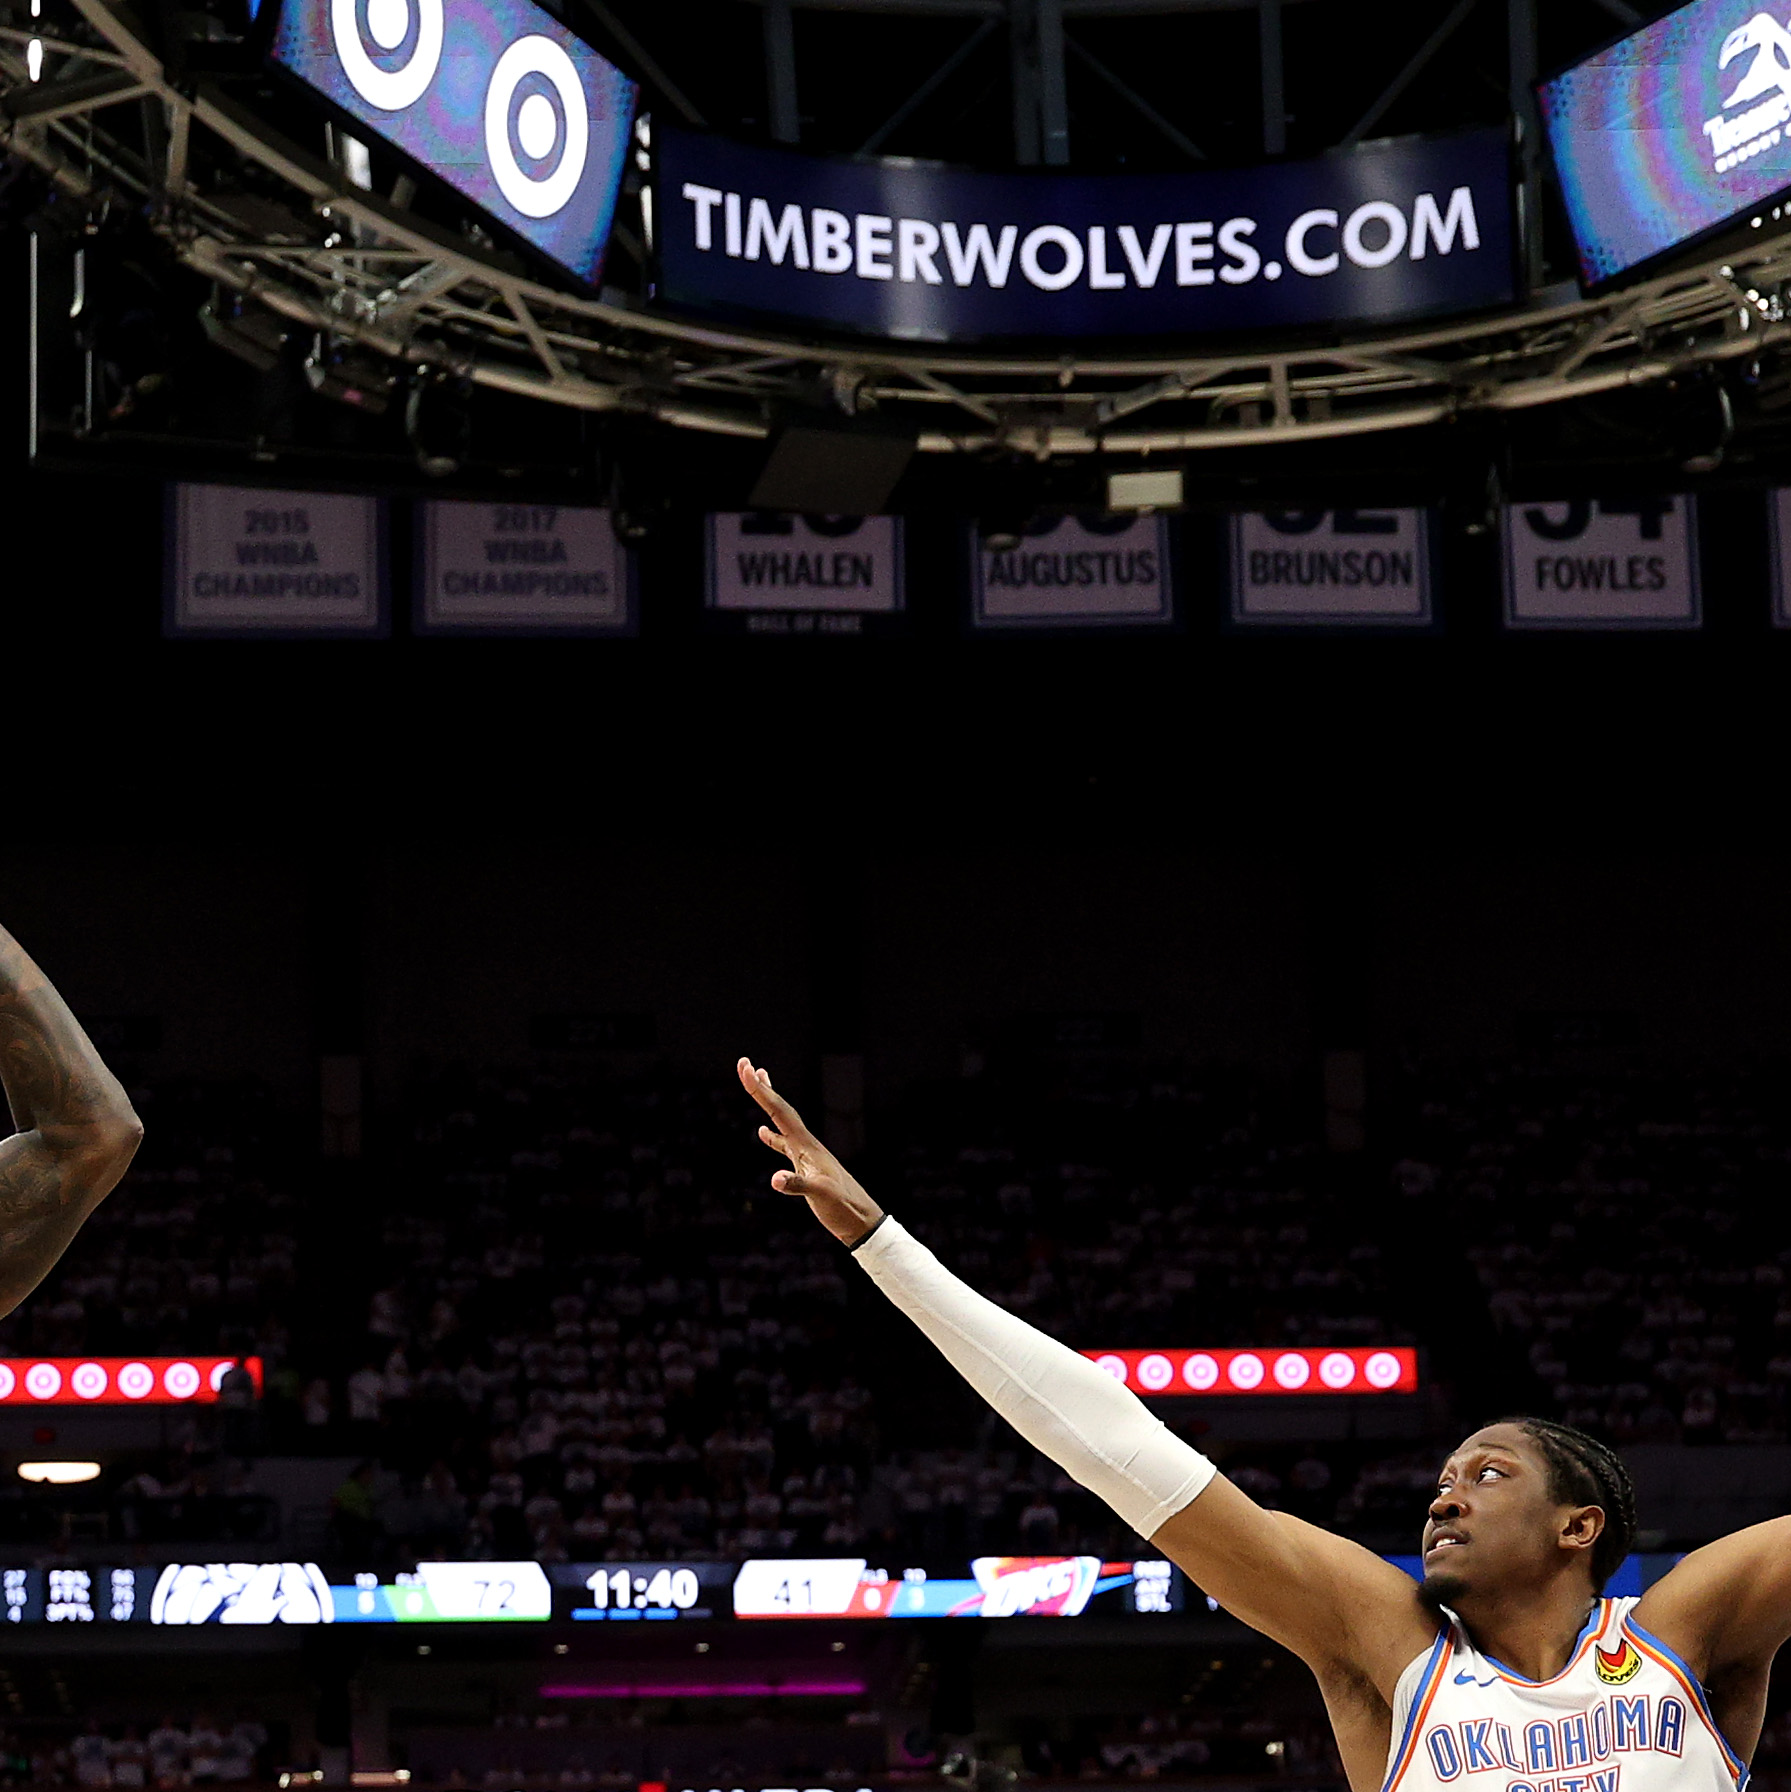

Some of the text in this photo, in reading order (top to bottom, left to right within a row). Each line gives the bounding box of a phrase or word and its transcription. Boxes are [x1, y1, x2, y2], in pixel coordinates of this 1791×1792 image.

[682, 183, 1481, 291] TIMBERWOLVES.COM
[494, 506, 558, 533] 2017
[235, 541, 319, 567] WNBA
[483, 538, 567, 566] WNBA
[737, 551, 874, 588] WHALEN
[988, 550, 1158, 588] AUGUSTUS
[1250, 550, 1411, 589] BRUNSON
[194, 572, 360, 600] CHAMPIONS
[443, 570, 607, 599] CHAMPIONS
[1536, 555, 1666, 591] FOWLES
[473, 1580, 516, 1610] 72
[585, 1568, 700, 1610] 11:40
[1426, 1693, 1687, 1783] OKLAHOMA
